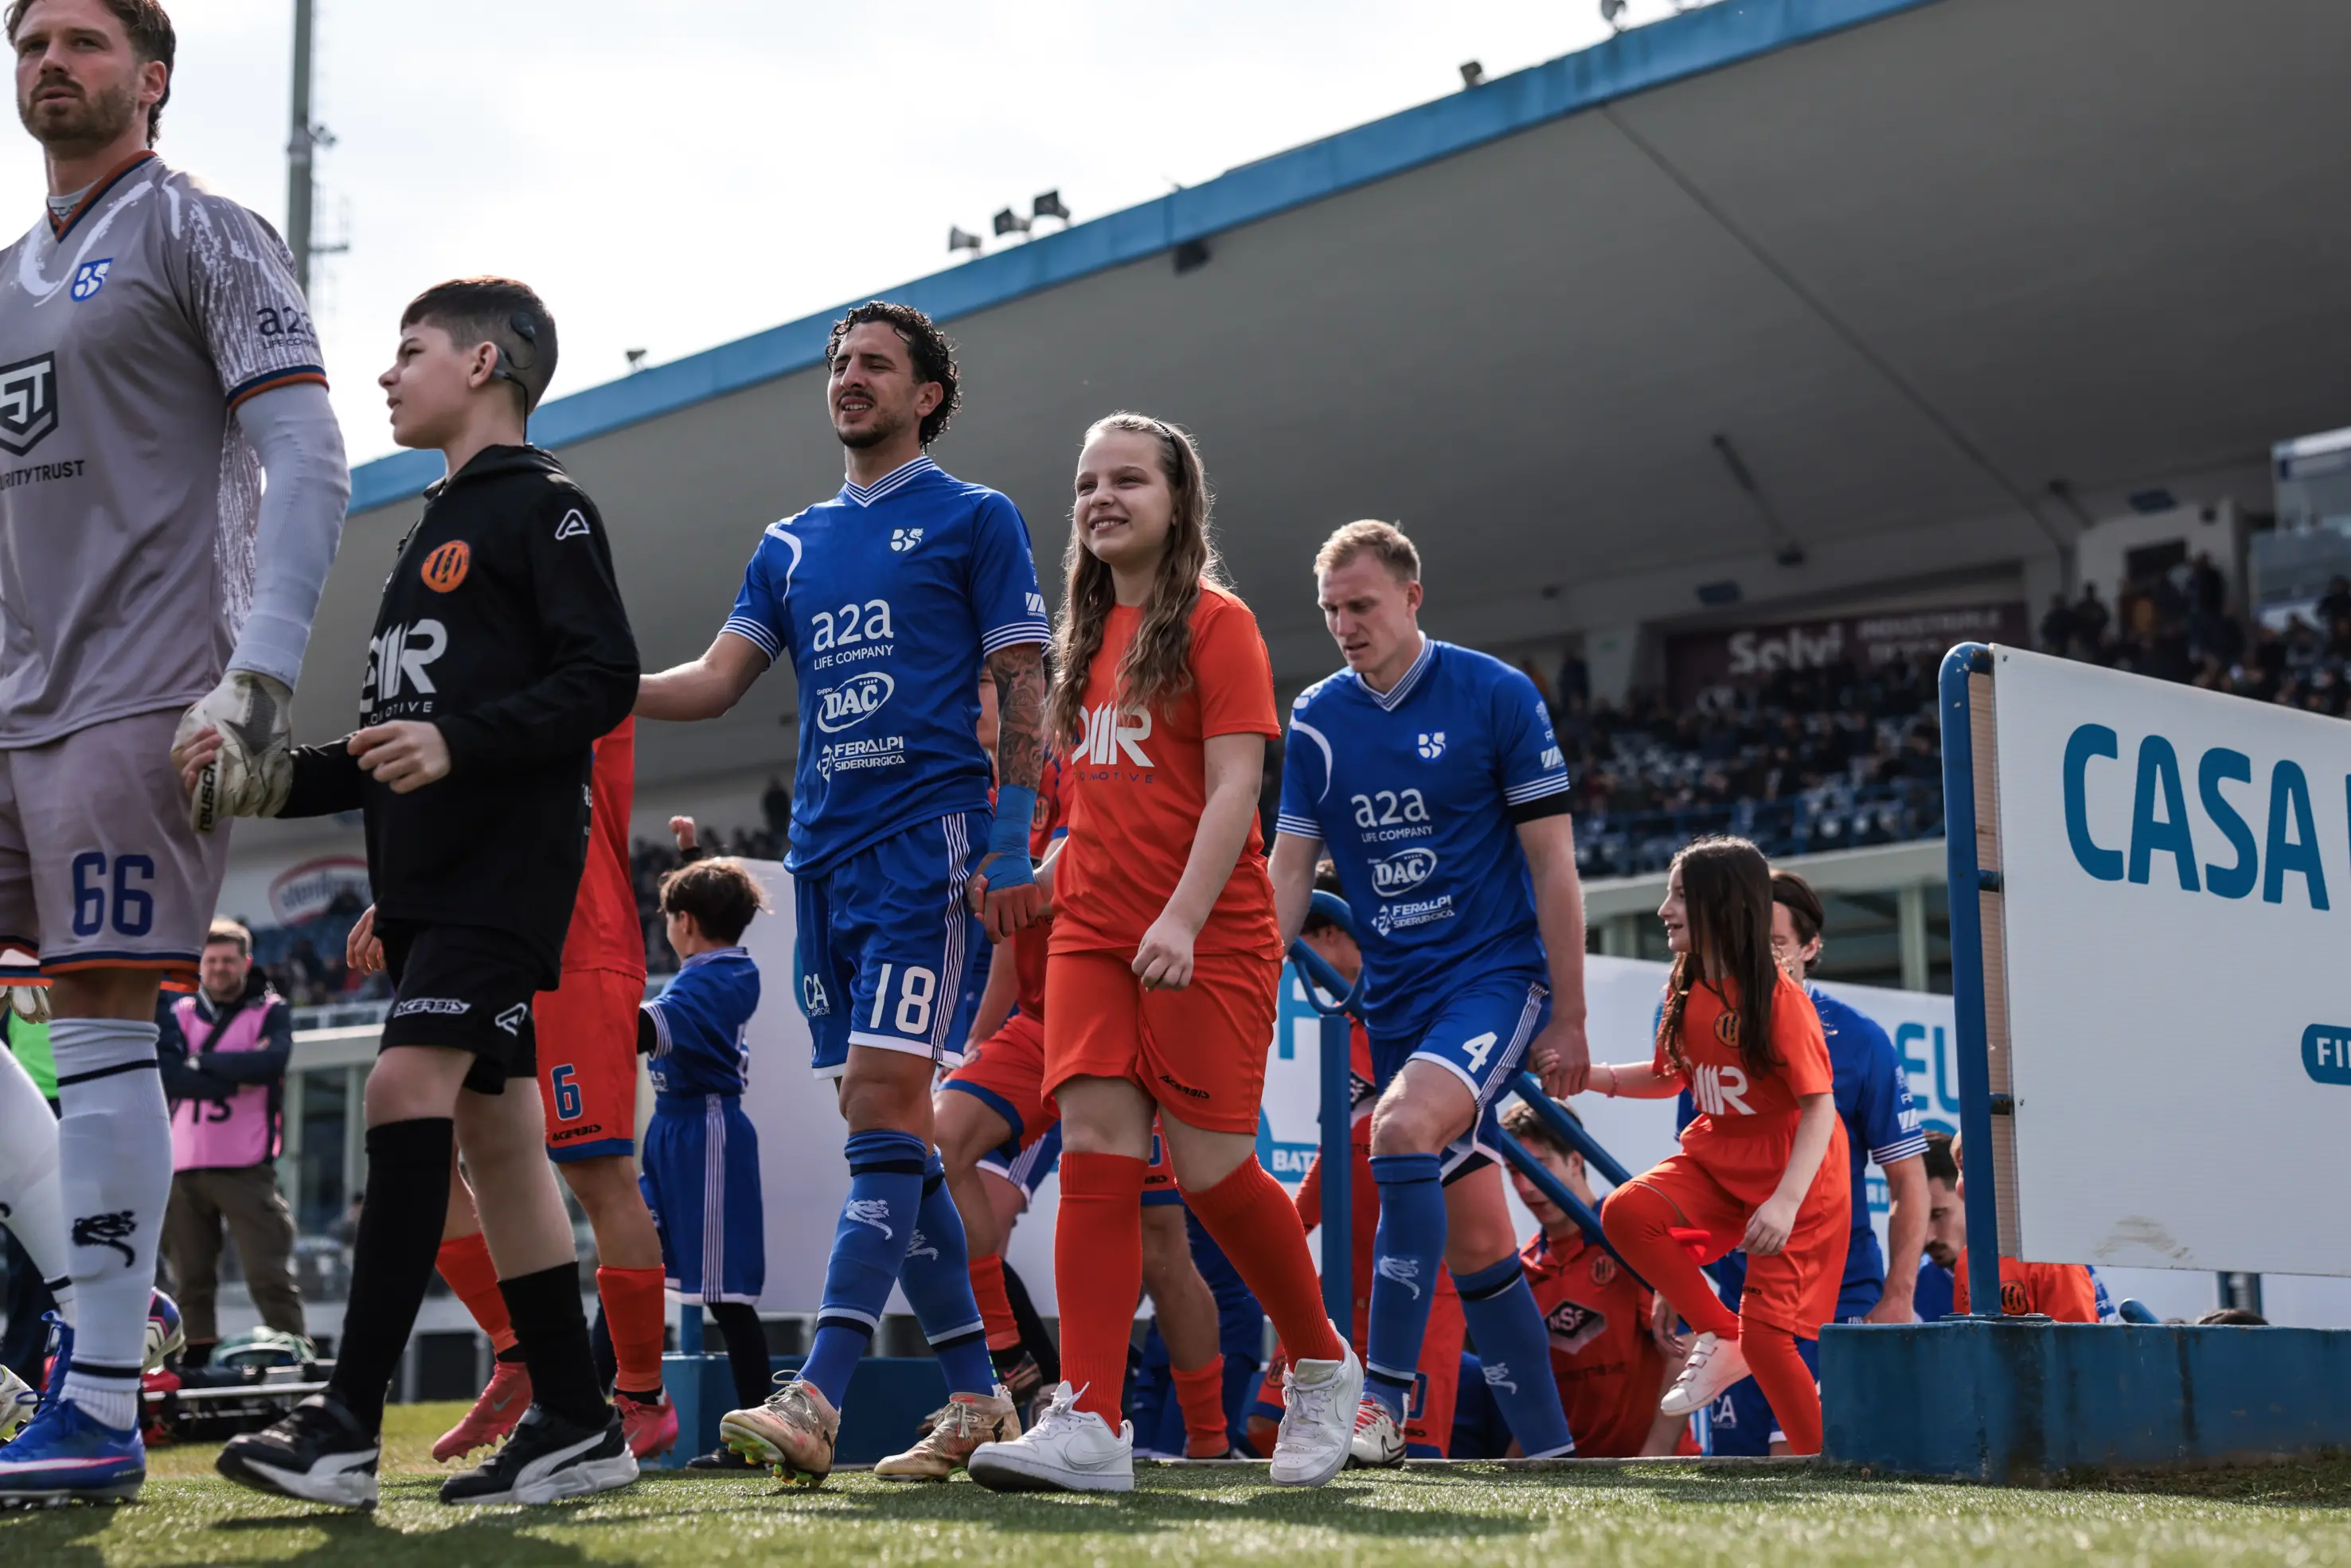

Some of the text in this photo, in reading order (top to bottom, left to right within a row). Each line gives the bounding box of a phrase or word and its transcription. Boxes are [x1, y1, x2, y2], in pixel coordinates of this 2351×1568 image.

[811, 599, 894, 652] a2a
[814, 645, 894, 670] LIFE COMPANY
[823, 684, 878, 720] DAC
[834, 735, 904, 757] FERALPI
[834, 755, 906, 771] SIDERURGICA
[1350, 788, 1431, 828] a2a
[2063, 723, 2330, 911] CASA
[1361, 825, 1433, 843] LIFE COMPANY
[1374, 858, 1426, 886] DAC
[72, 852, 154, 937] 66
[1392, 894, 1452, 917] FERALPI
[1393, 909, 1456, 929] SIDERURGICA
[395, 998, 468, 1017] ACERBIS
[870, 963, 936, 1035] 18
[1462, 1032, 1498, 1074] 4
[551, 1063, 584, 1121] 6
[1159, 1075, 1210, 1100] ACERBIS
[553, 1123, 603, 1141] ACERBIS
